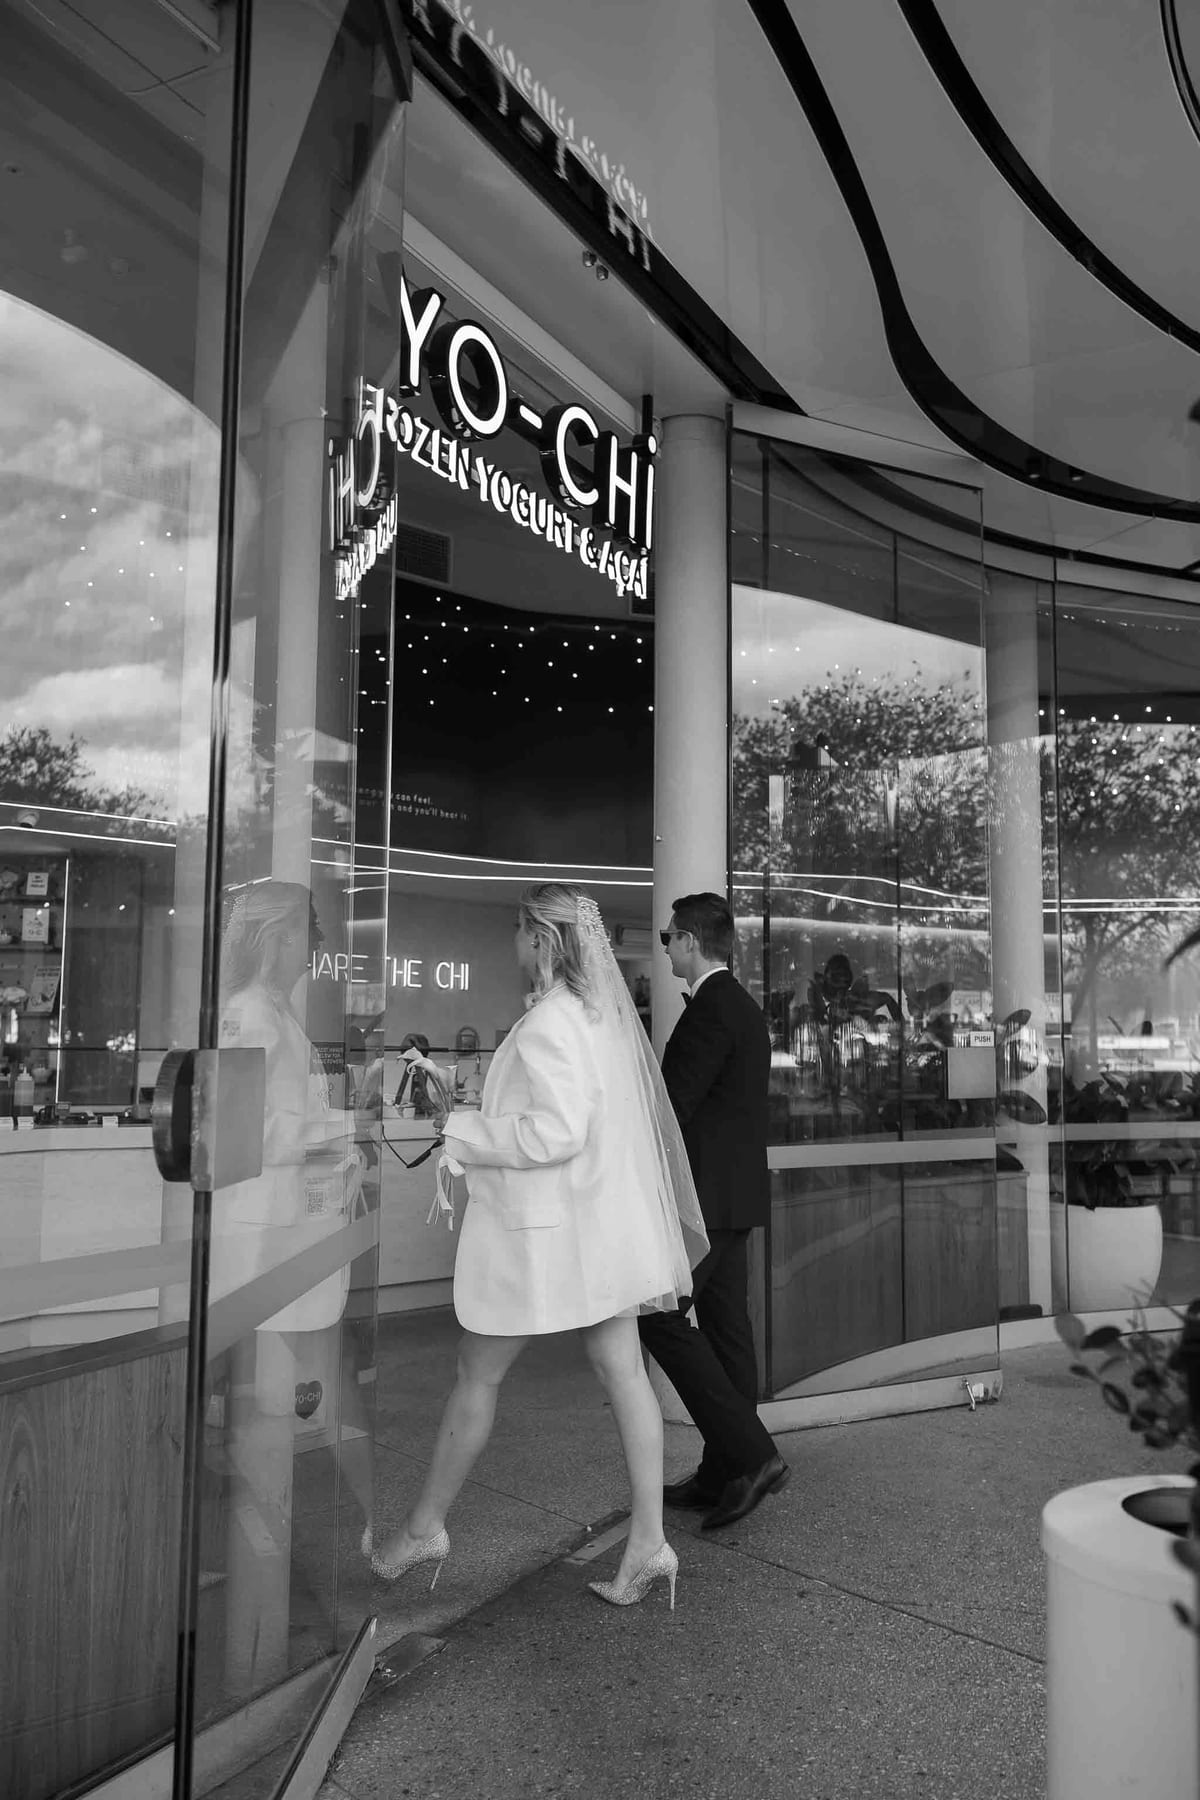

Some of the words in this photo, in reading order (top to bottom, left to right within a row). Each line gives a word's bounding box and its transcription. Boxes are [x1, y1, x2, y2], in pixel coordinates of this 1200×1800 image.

[475, 456, 579, 553] YOGURT
[579, 527, 598, 569] &
[436, 961, 469, 990] CHI
[974, 1035, 991, 1043] PUSH
